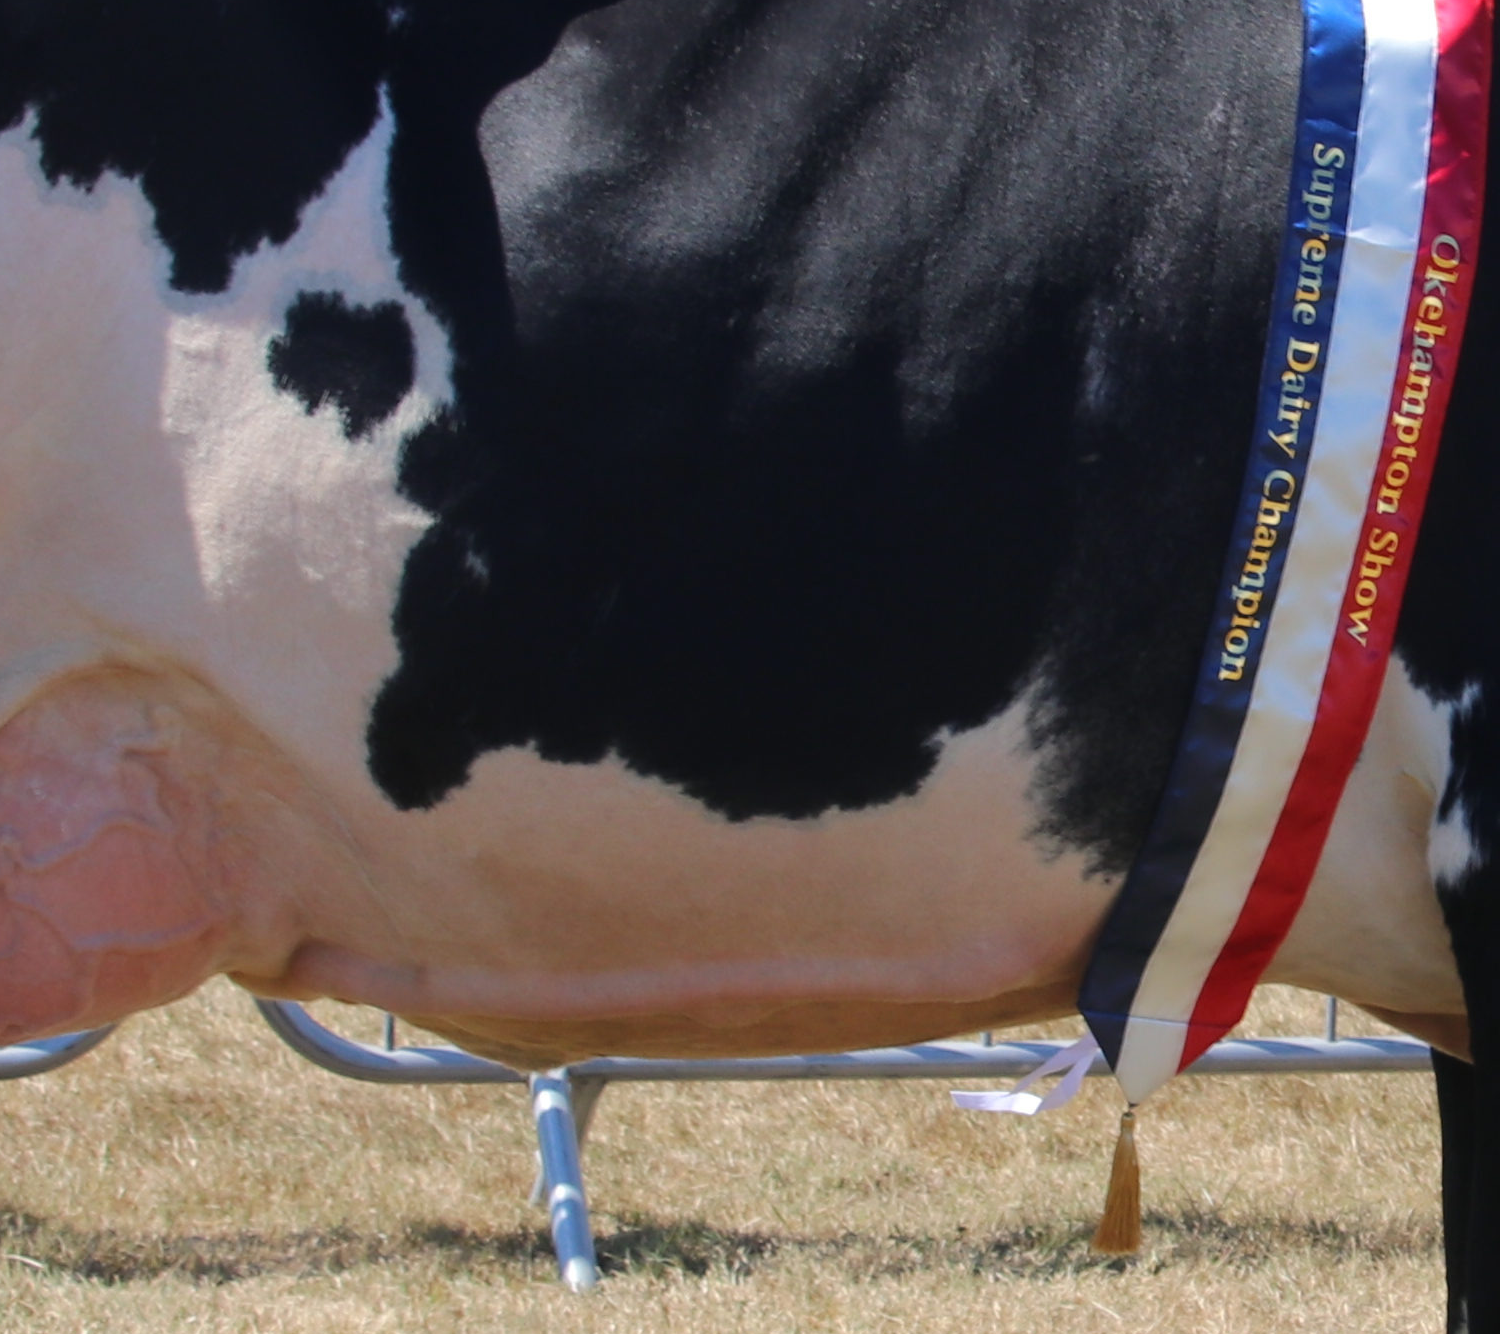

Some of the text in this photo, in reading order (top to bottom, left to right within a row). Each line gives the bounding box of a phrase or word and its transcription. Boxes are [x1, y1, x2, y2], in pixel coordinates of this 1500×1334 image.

[1217, 142, 1346, 682] Supreme Dairy Champion
[1347, 233, 1461, 648] Okehampton Show
